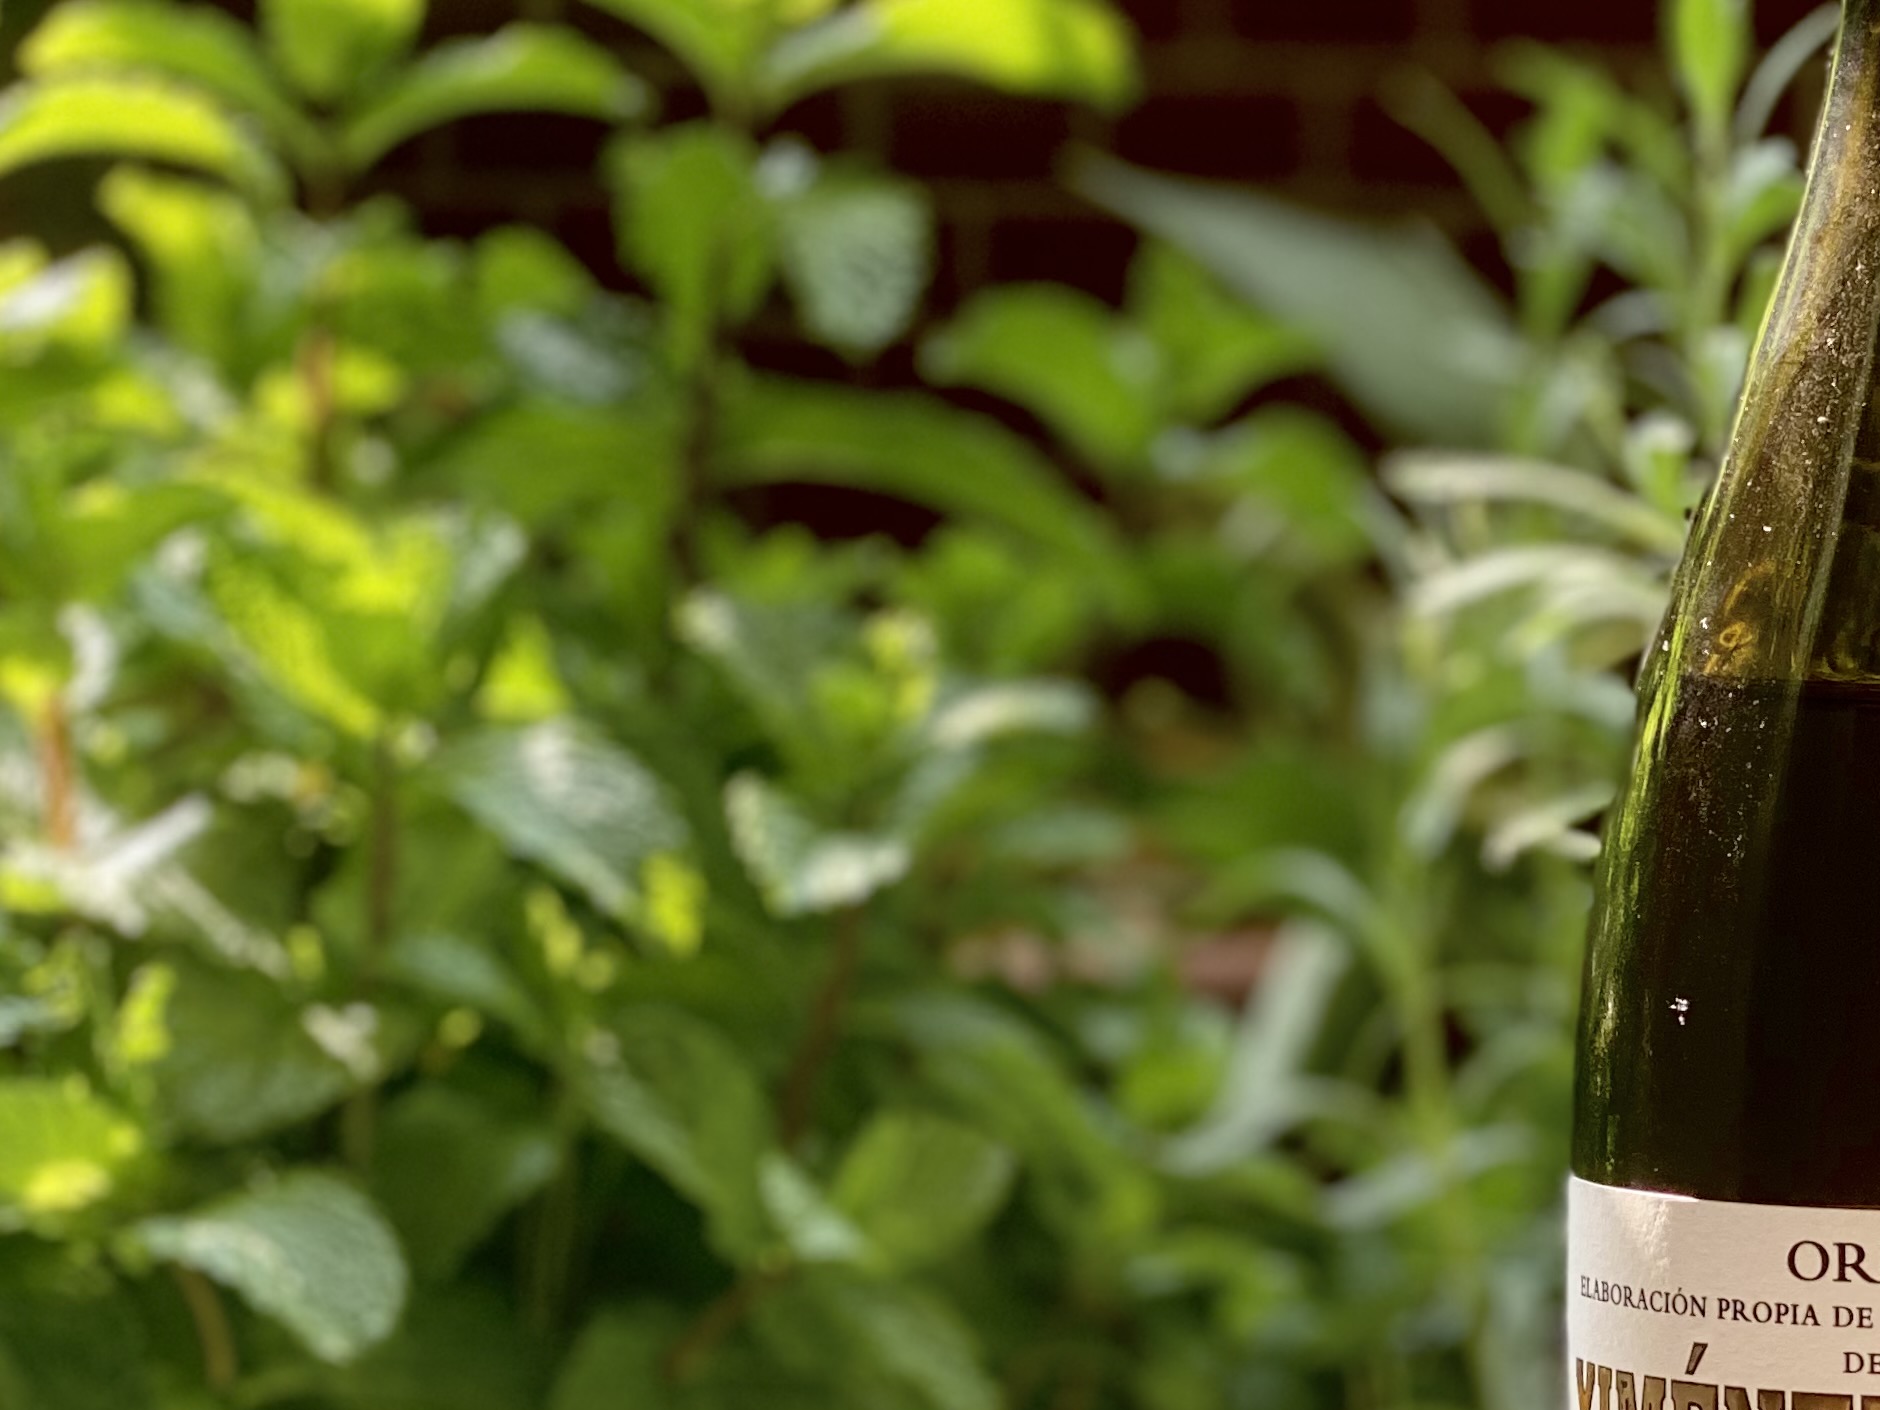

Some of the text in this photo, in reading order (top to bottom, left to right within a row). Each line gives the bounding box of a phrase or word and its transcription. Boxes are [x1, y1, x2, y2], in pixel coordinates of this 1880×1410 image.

[1580, 1275, 1707, 1318] ELABORACIÓN
[1717, 1298, 1821, 1327] PROPIA
[1832, 1306, 1873, 1329] DE
